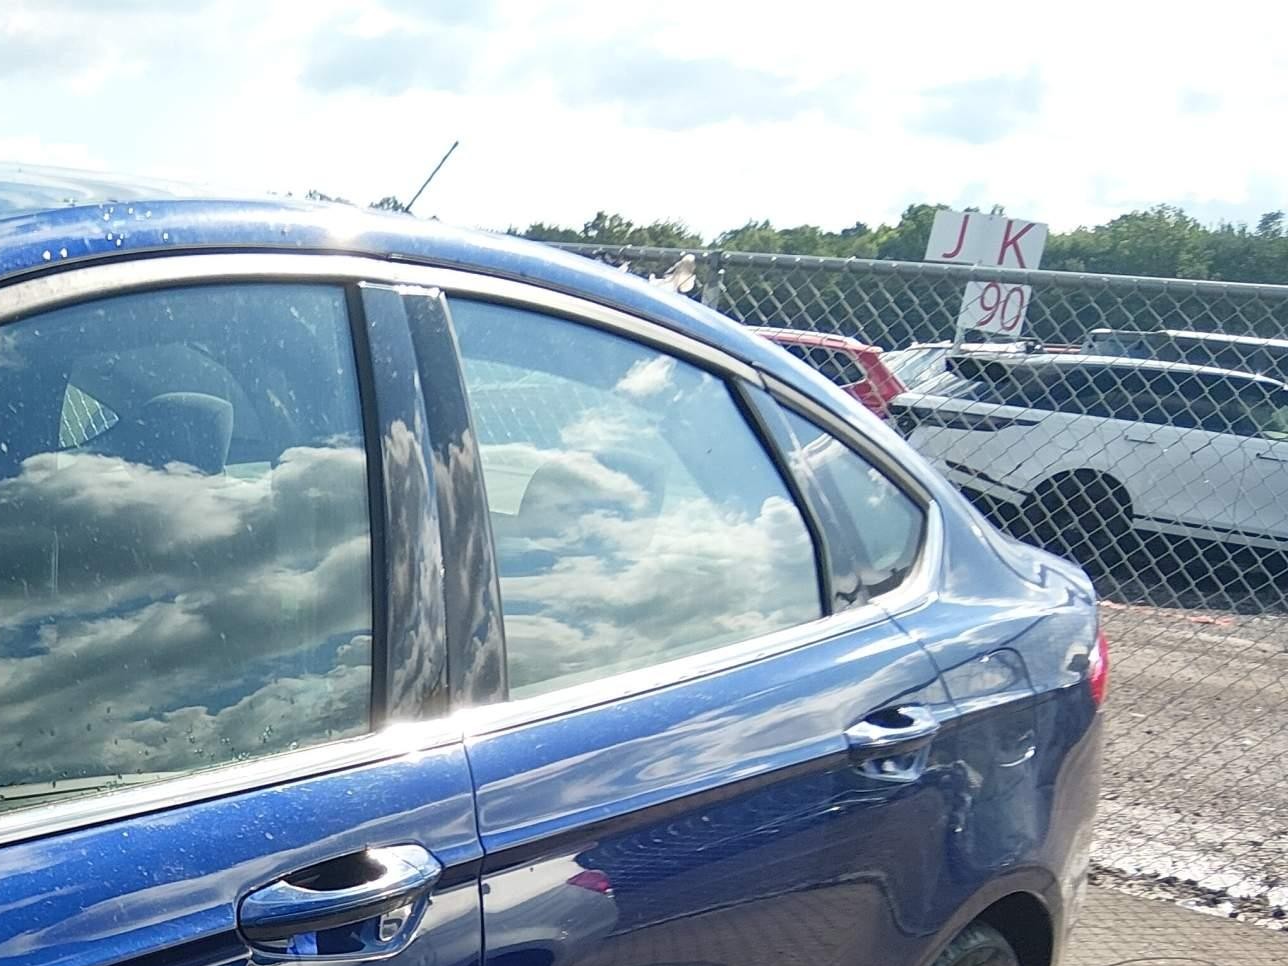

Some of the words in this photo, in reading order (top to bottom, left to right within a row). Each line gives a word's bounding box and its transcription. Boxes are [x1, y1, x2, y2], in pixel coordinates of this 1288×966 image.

[942, 214, 970, 258] J
[997, 219, 1036, 268] K
[978, 282, 1024, 331] 90
